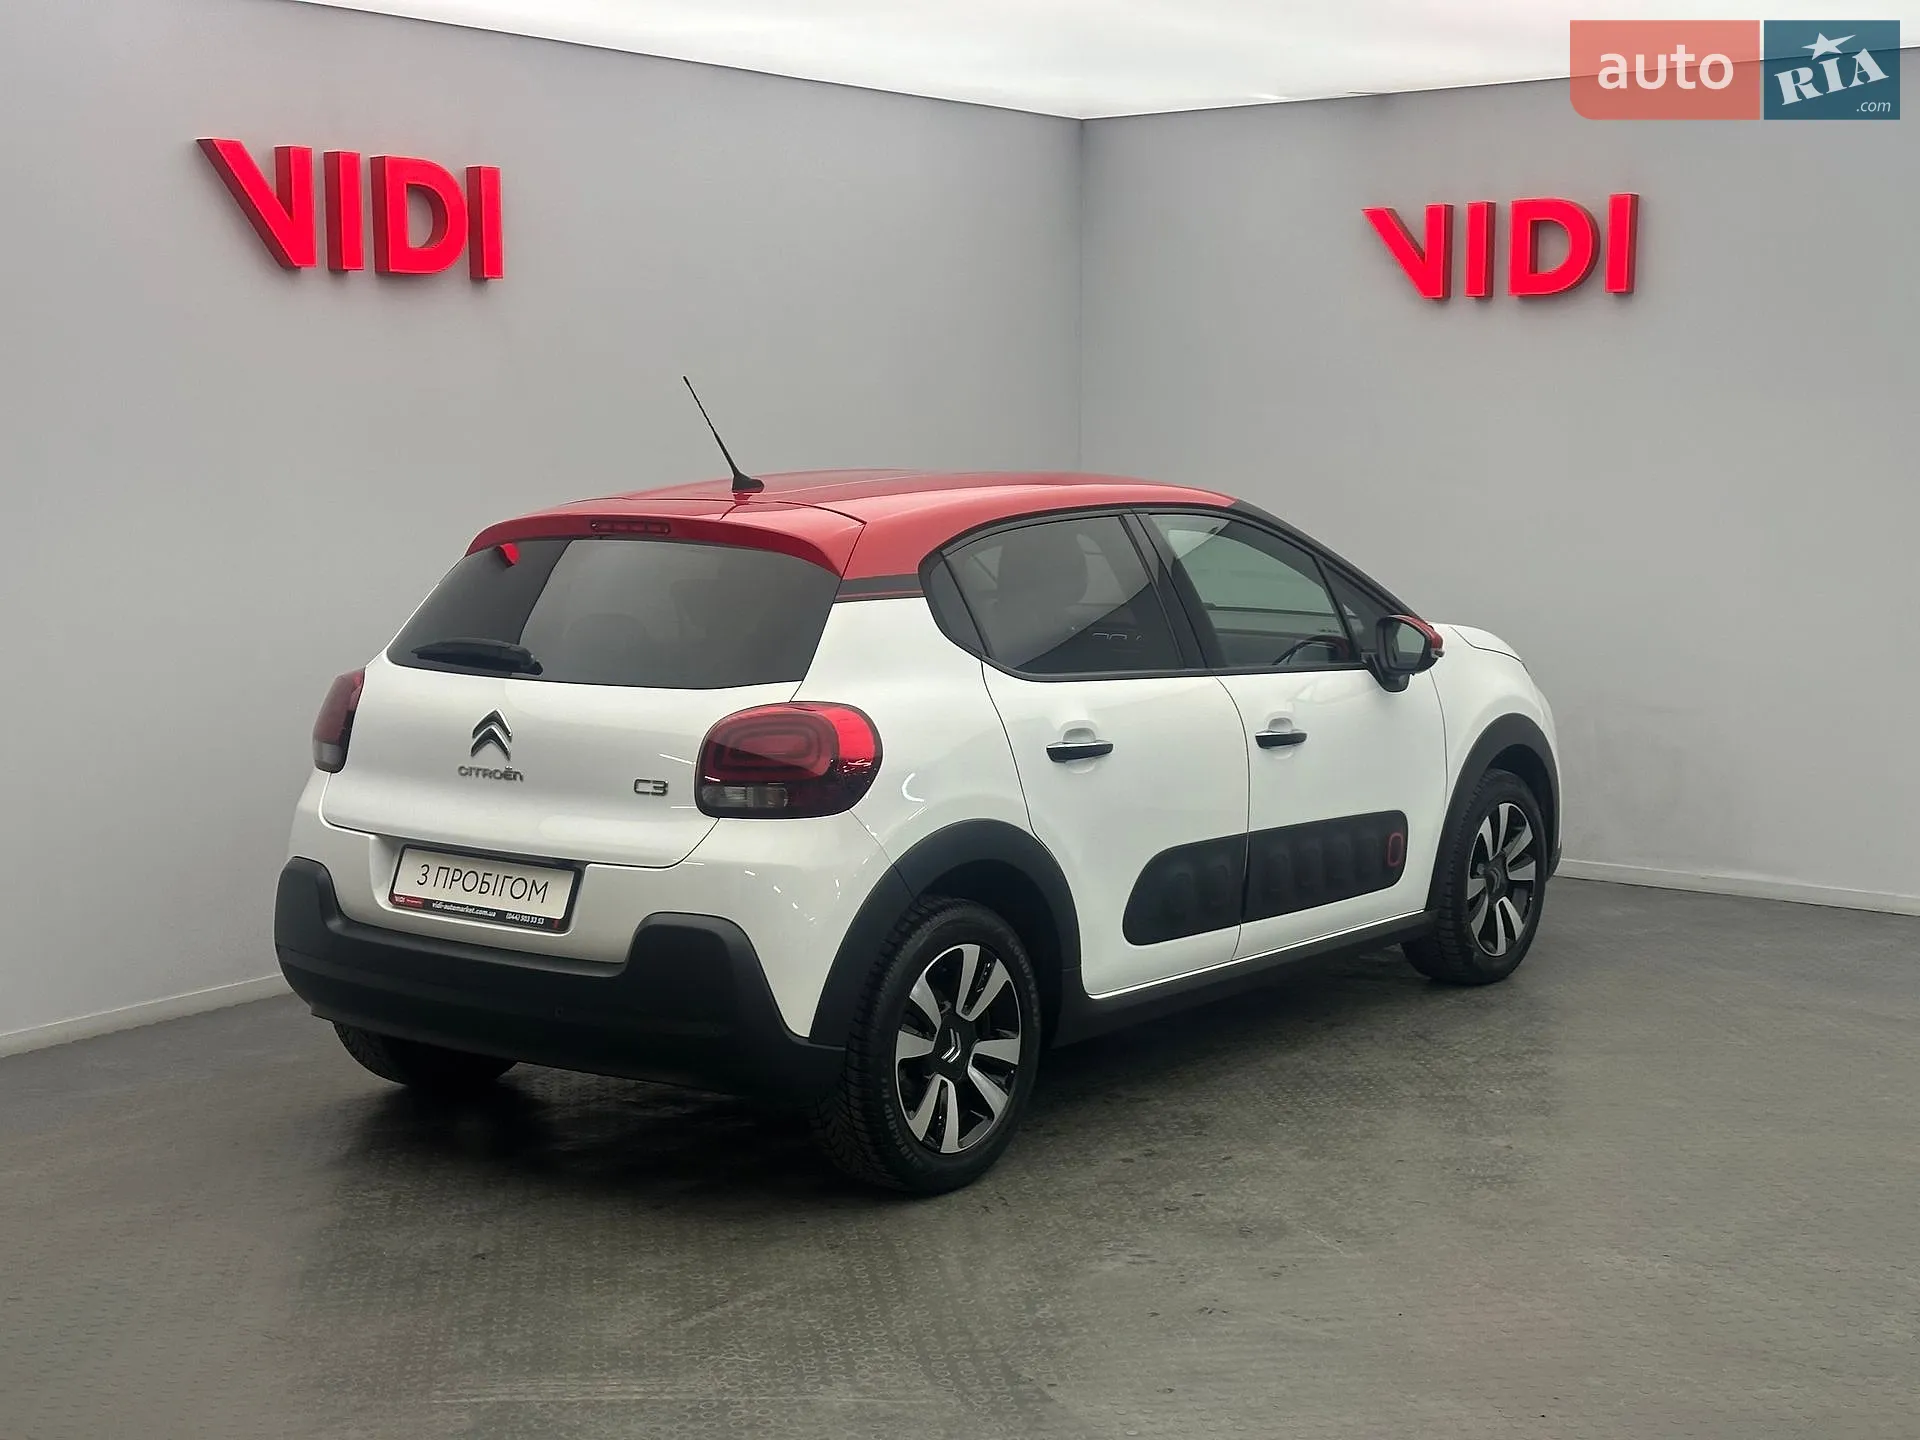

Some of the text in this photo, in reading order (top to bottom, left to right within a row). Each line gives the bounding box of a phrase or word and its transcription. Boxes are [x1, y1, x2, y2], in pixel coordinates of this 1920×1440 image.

[194, 137, 504, 280] VIDI
[1361, 192, 1640, 299] VIDI
[634, 778, 669, 797] C3
[433, 866, 549, 904] ПРОБІГОМ
